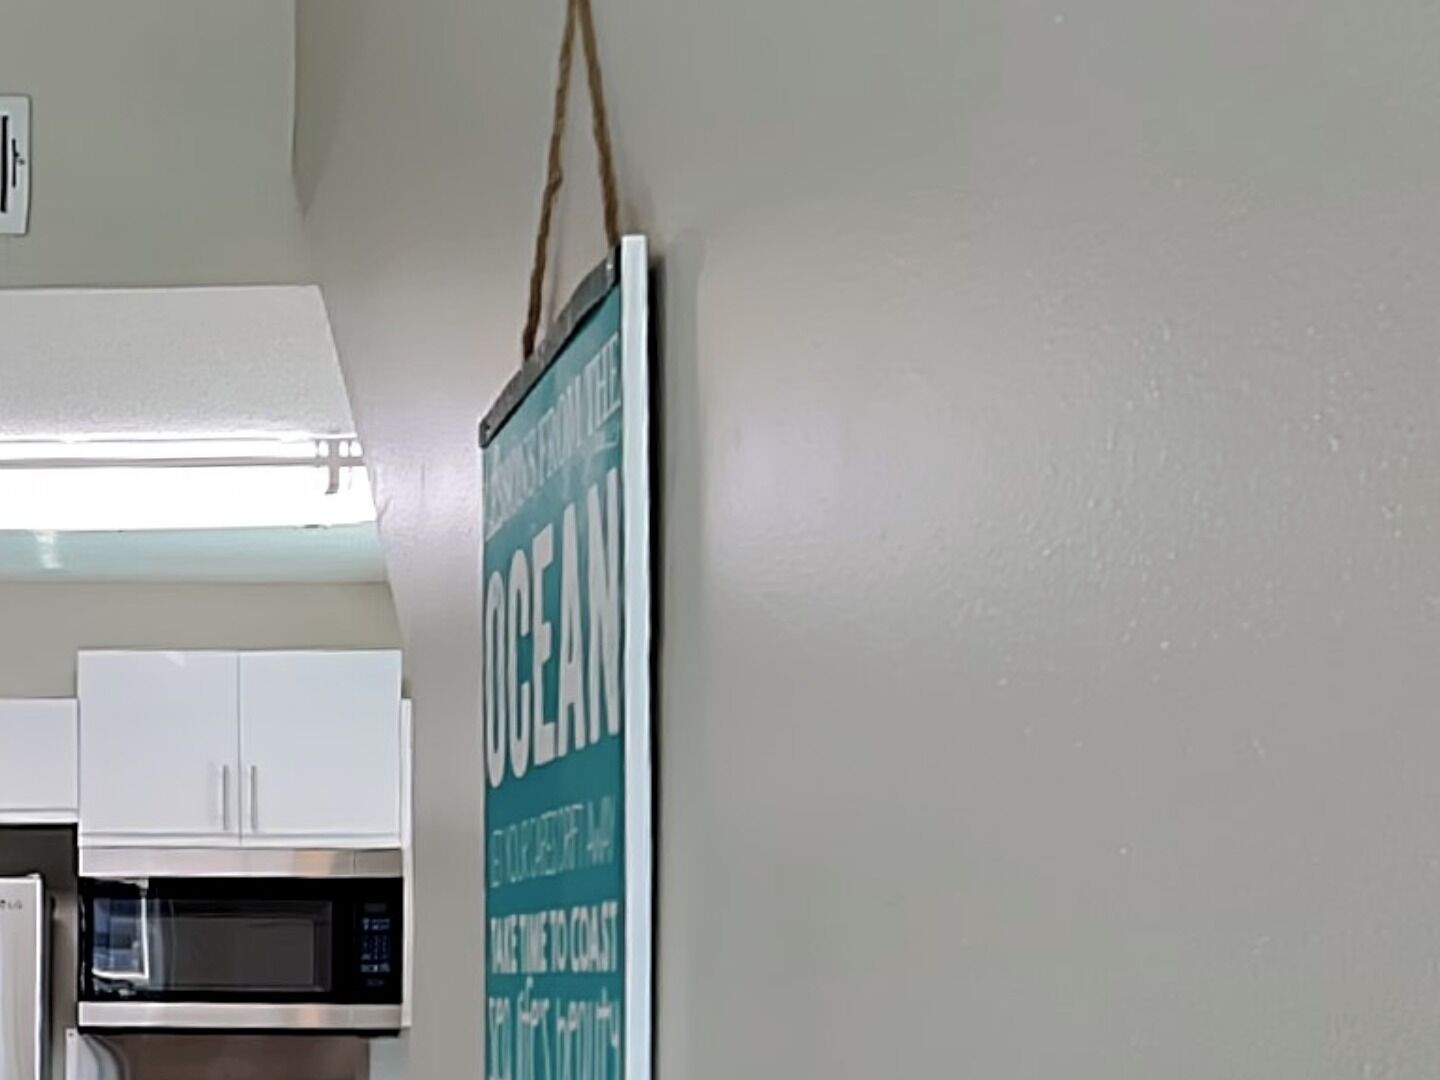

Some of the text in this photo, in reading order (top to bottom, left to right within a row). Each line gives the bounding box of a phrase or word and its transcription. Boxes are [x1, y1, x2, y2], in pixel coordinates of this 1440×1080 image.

[583, 331, 621, 437] THE
[485, 467, 620, 787] OCEAN
[490, 900, 617, 974] TAKE TIME TO COAST
